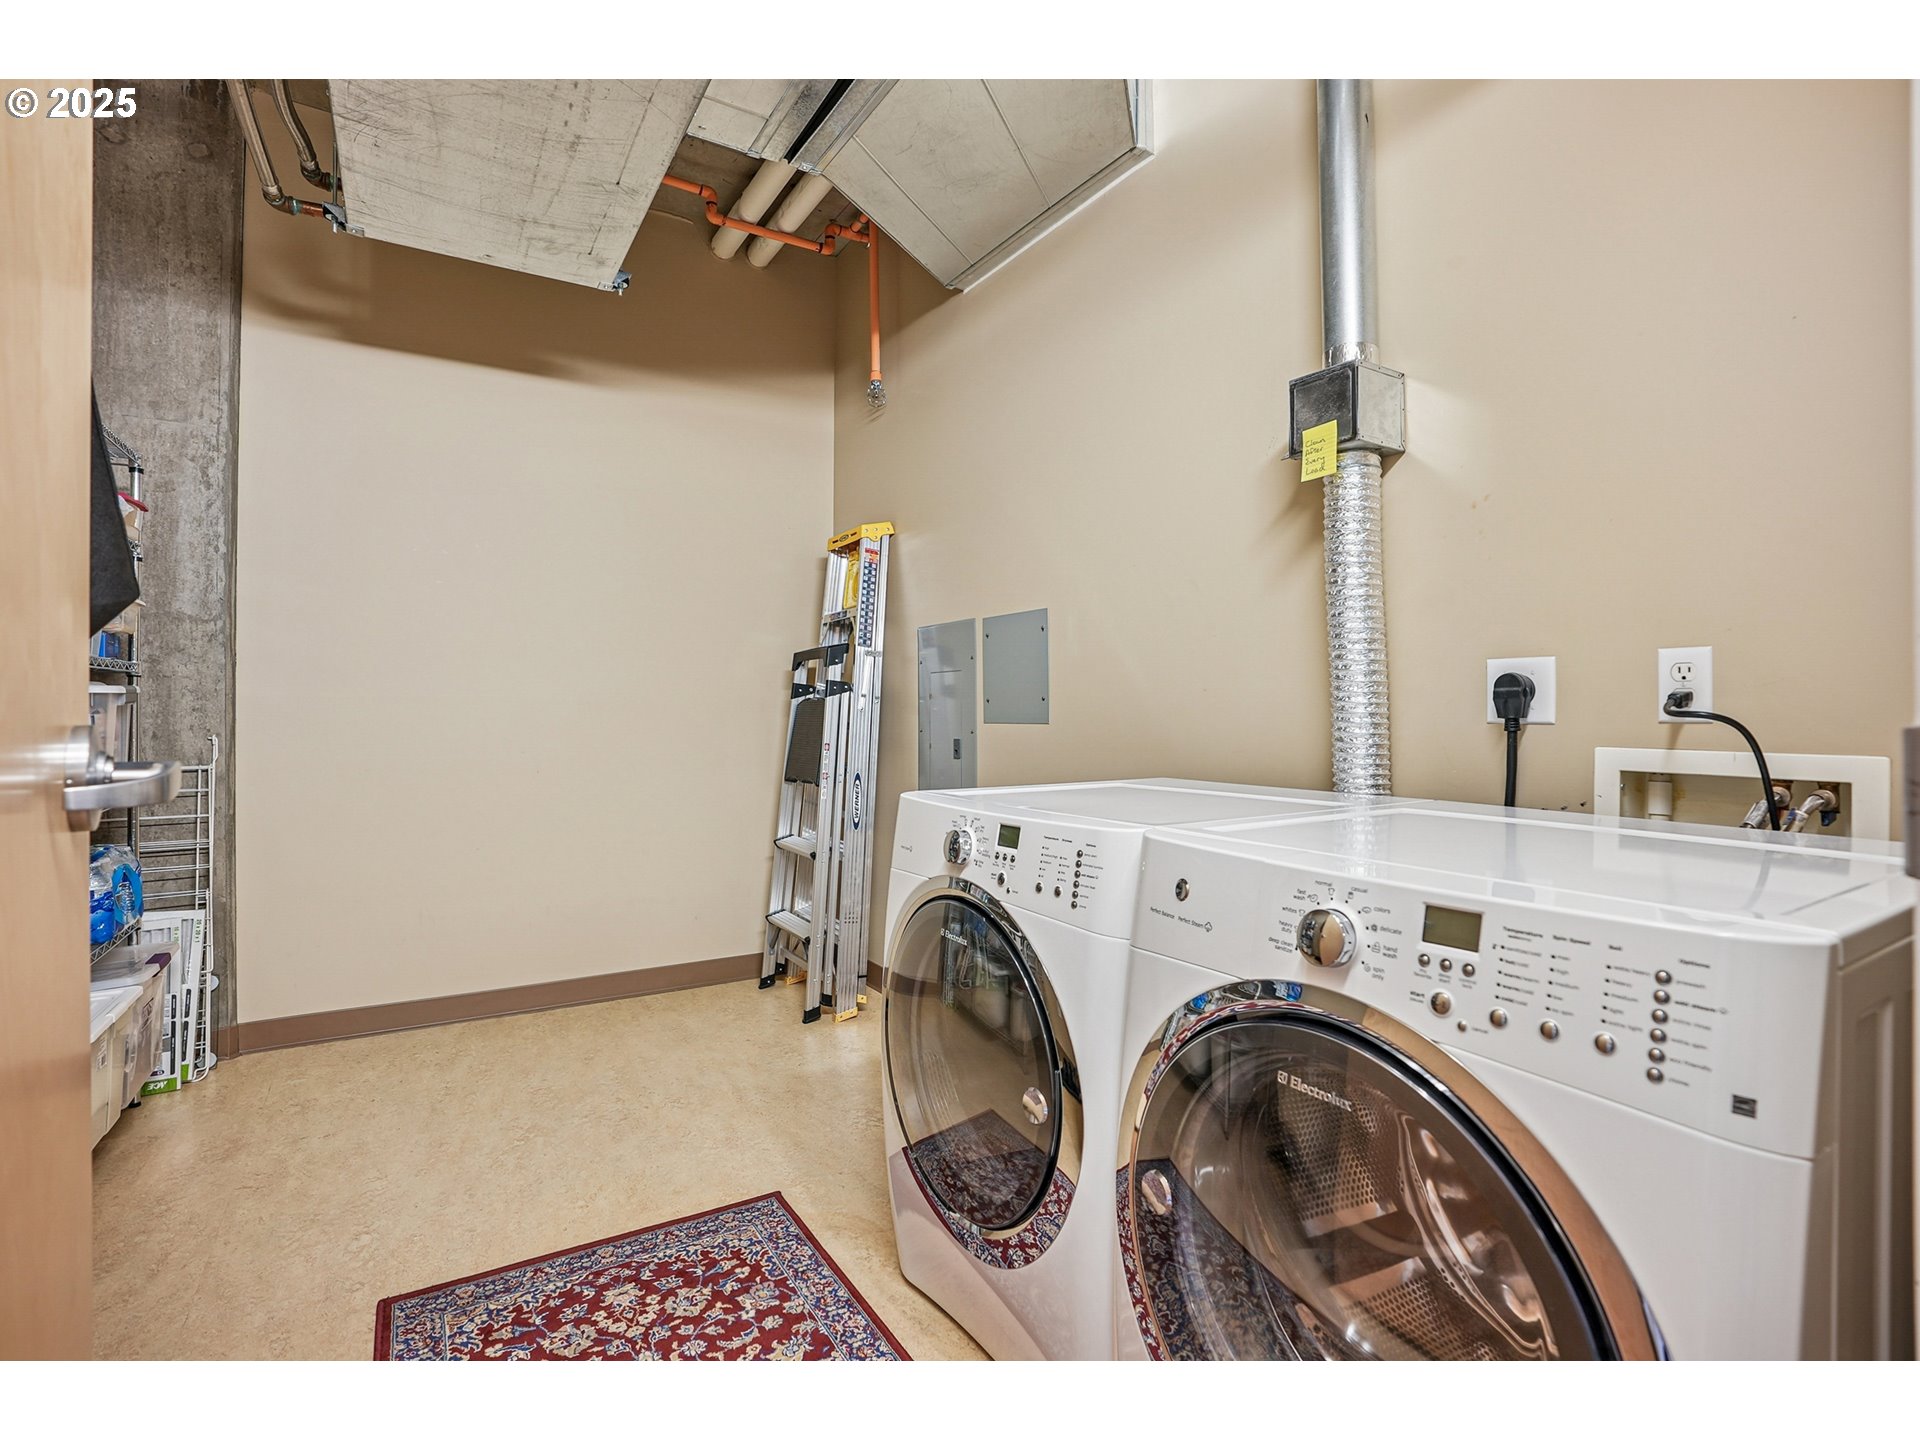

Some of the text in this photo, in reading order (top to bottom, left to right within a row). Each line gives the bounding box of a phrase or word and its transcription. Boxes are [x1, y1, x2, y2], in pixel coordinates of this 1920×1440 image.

[1305, 447, 1324, 457] After
[1305, 457, 1326, 466] Every
[1305, 464, 1326, 476] Load
[1282, 906, 1297, 914] whites
[1373, 906, 1391, 914] colors
[1379, 925, 1402, 935] delicate
[945, 929, 967, 946] Electrolux
[1382, 952, 1397, 960] wash
[147, 1080, 168, 1091] ACE
[1289, 1075, 1352, 1112] Electrolux
